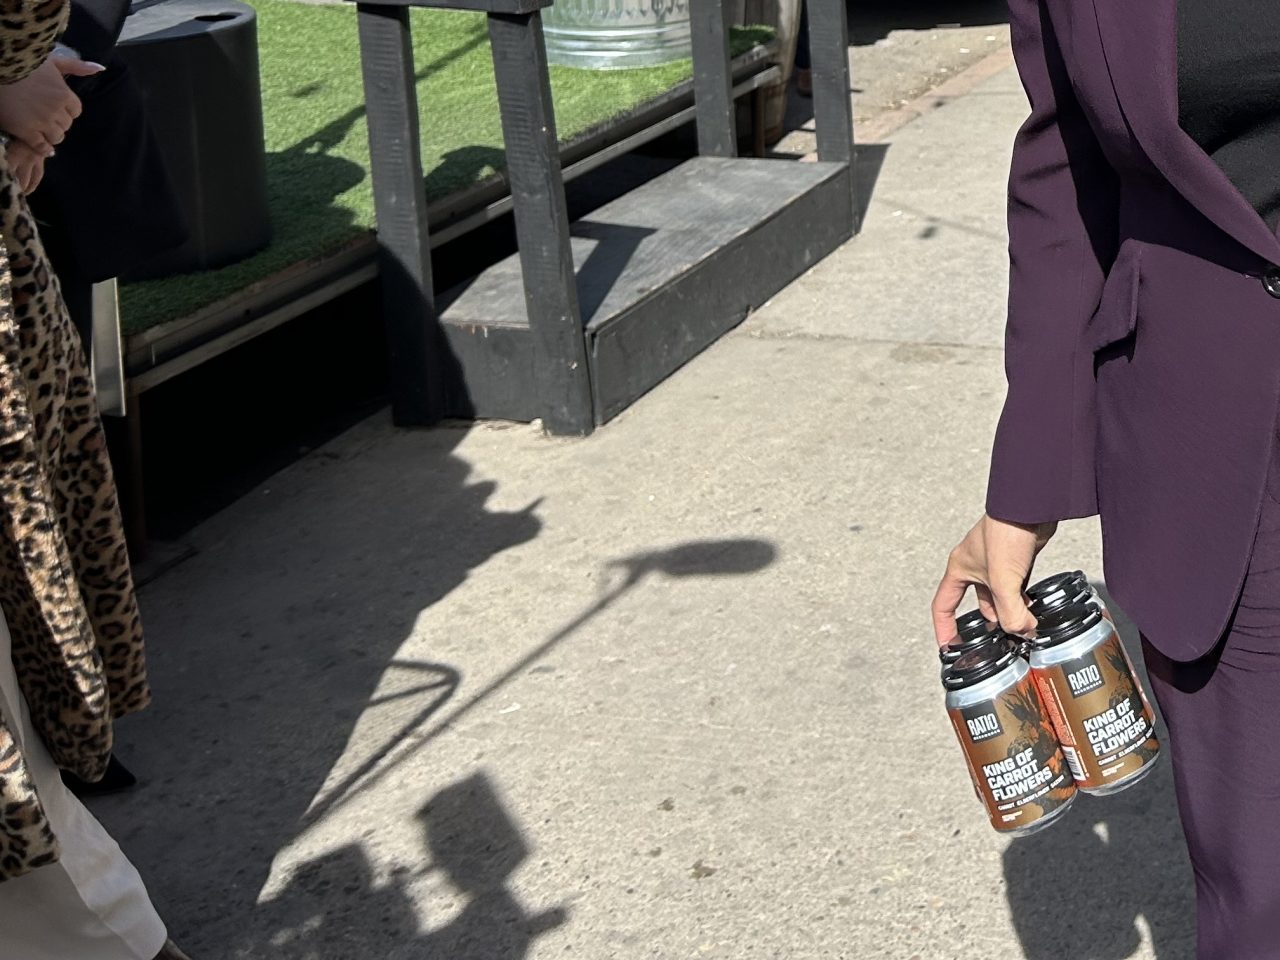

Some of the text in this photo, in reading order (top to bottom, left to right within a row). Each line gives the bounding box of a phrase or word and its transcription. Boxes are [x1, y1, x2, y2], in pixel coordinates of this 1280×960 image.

[1067, 664, 1101, 691] RATIO
[967, 713, 999, 737] RATIO
[1083, 698, 1131, 733] KING OF
[1087, 710, 1136, 745] CARROT
[1092, 716, 1147, 757] FLOWERS
[982, 747, 1034, 778] KING OF
[987, 759, 1039, 790] CARROT
[992, 765, 1053, 802] FLOWERS
